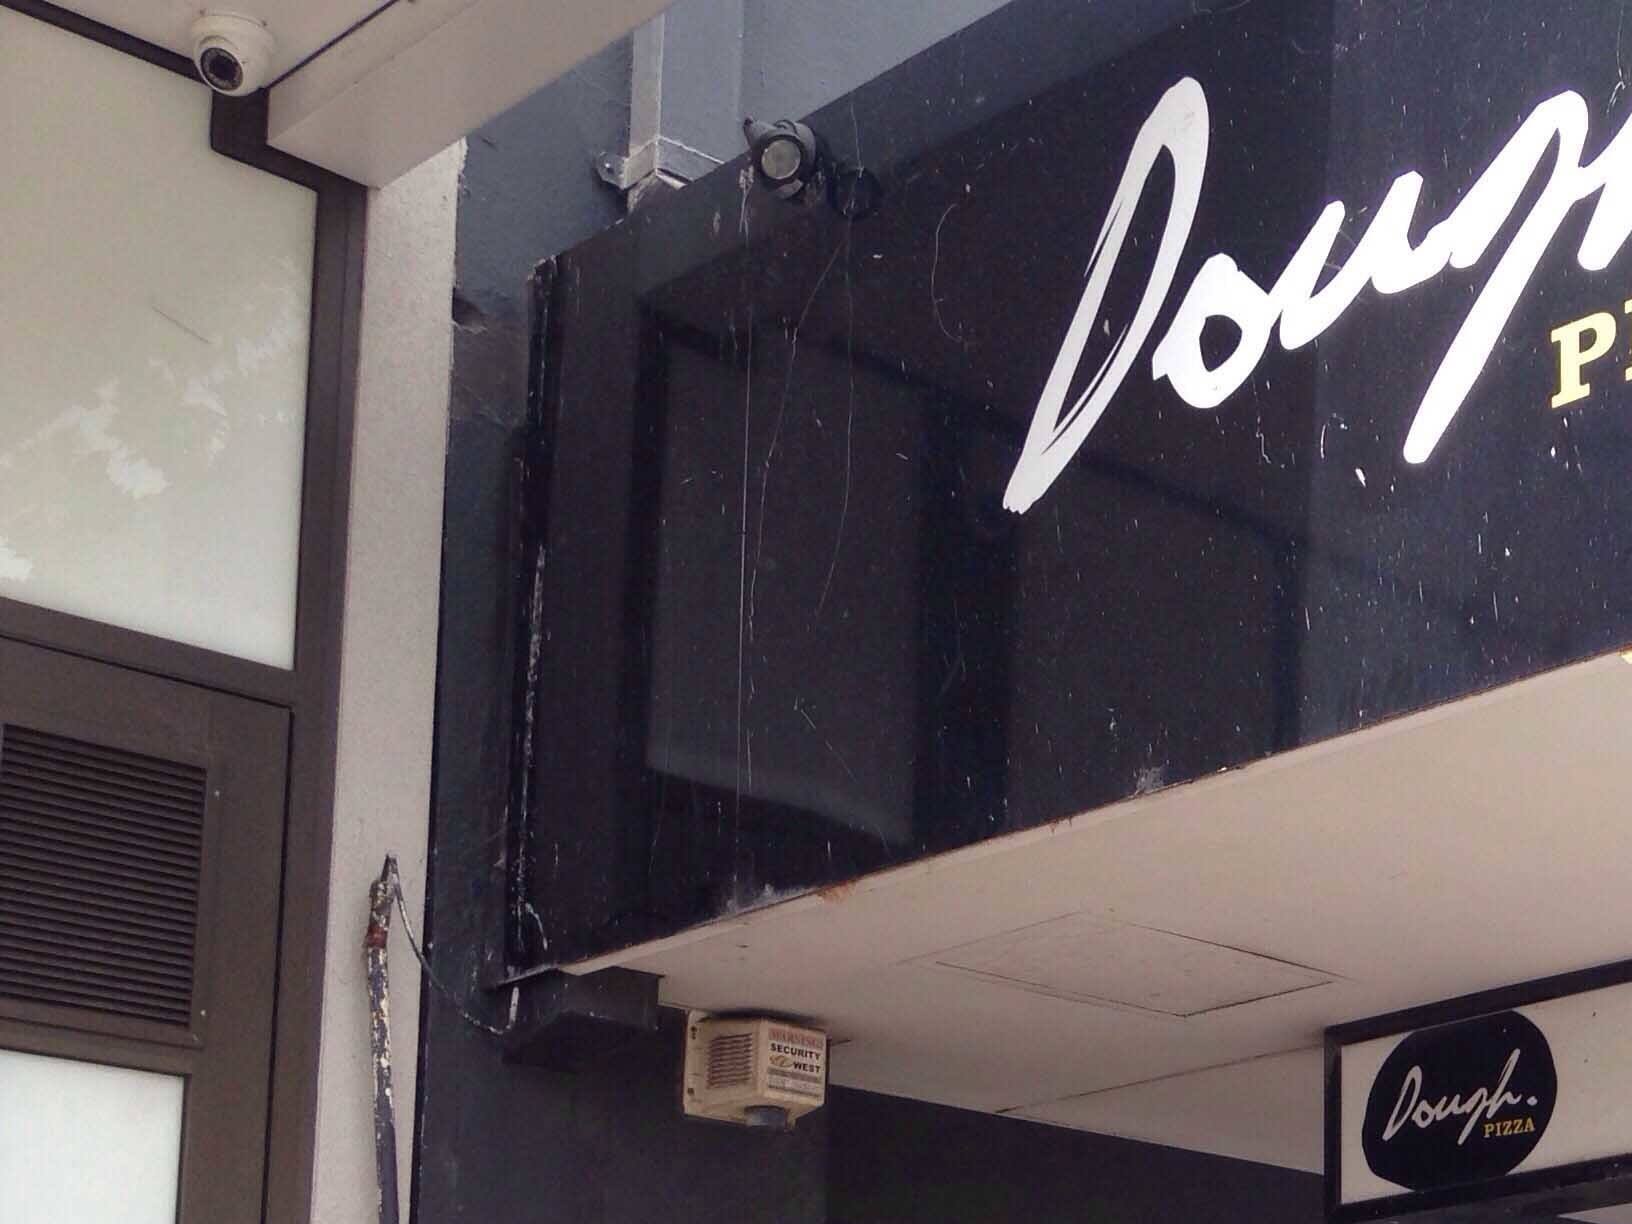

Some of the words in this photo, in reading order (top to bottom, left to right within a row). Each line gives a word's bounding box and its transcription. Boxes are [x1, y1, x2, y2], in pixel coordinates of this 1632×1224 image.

[770, 1043, 821, 1060] SECURITY
[793, 1062, 821, 1073] WEST
[1483, 1118, 1535, 1138] PIZZA
